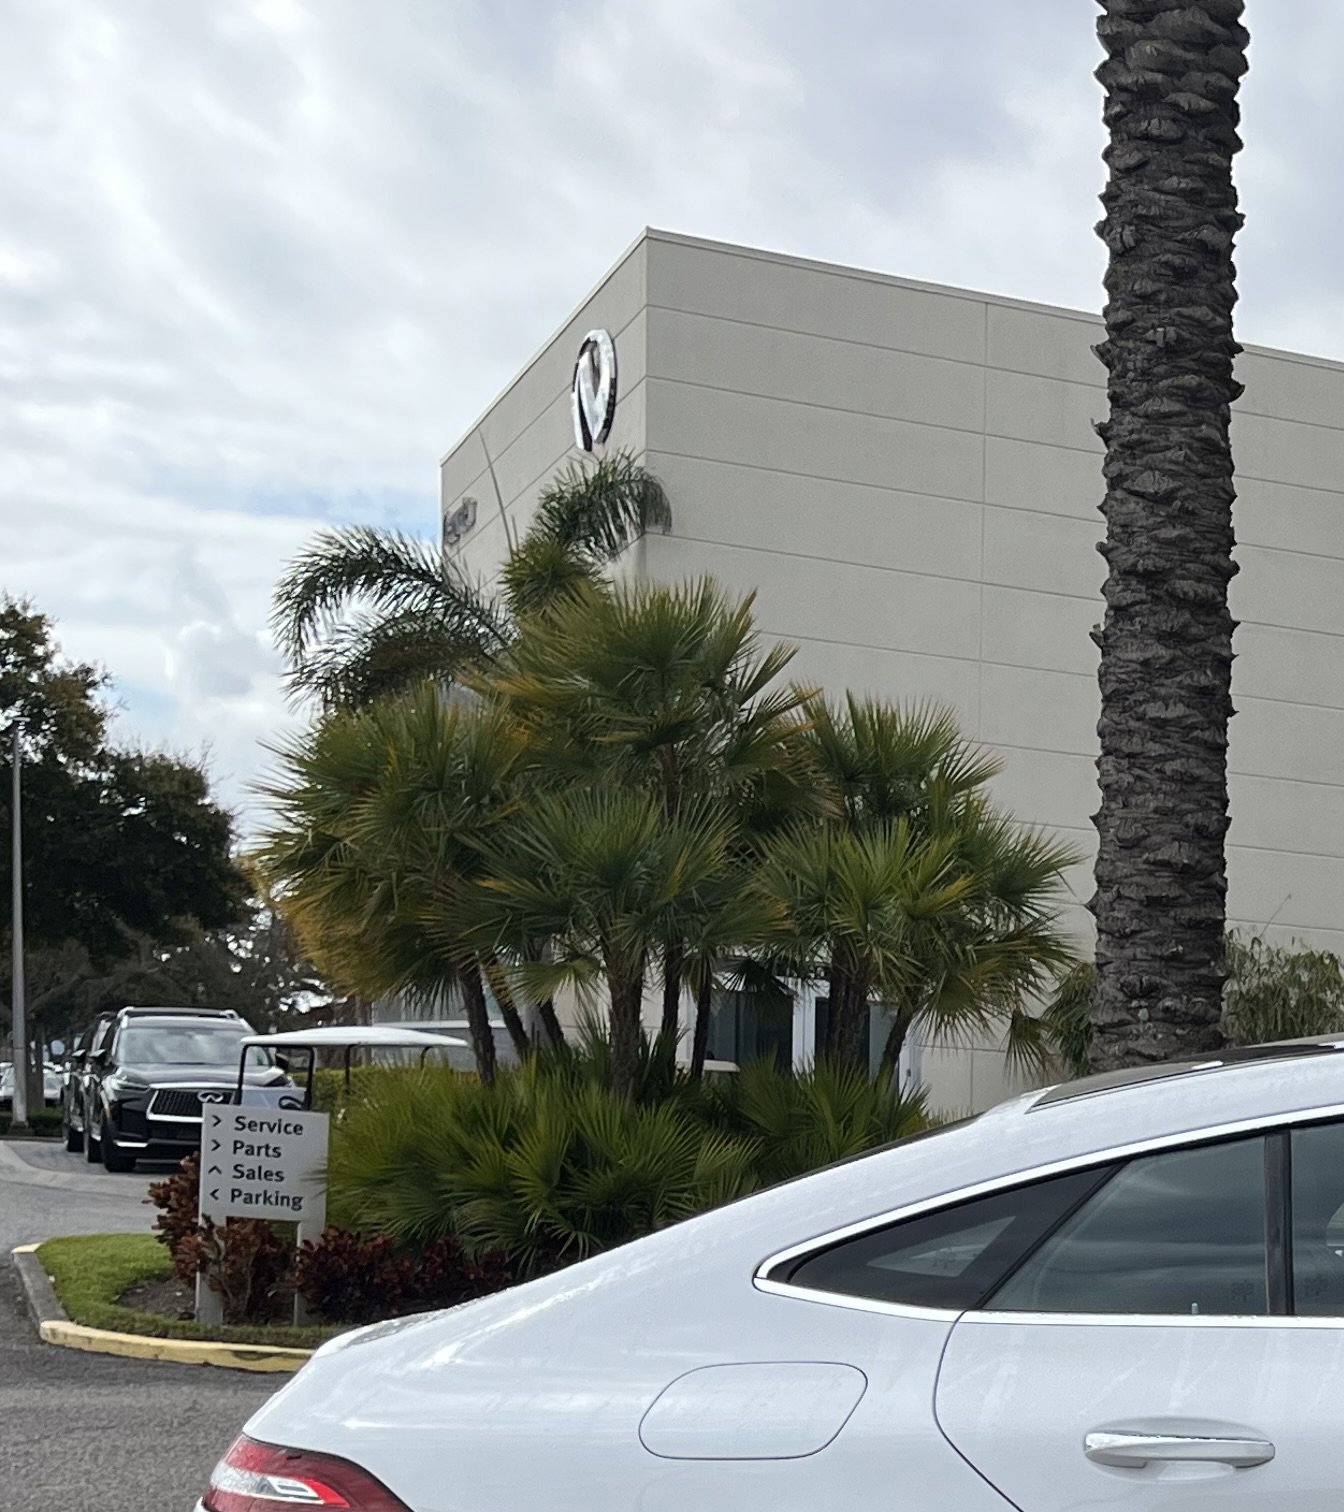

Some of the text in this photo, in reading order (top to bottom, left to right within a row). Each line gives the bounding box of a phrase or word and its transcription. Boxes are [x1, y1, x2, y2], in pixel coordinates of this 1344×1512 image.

[234, 1115, 303, 1136] Service
[232, 1140, 282, 1158] Parts
[232, 1164, 285, 1182] Sales
[230, 1188, 303, 1212] Parking
